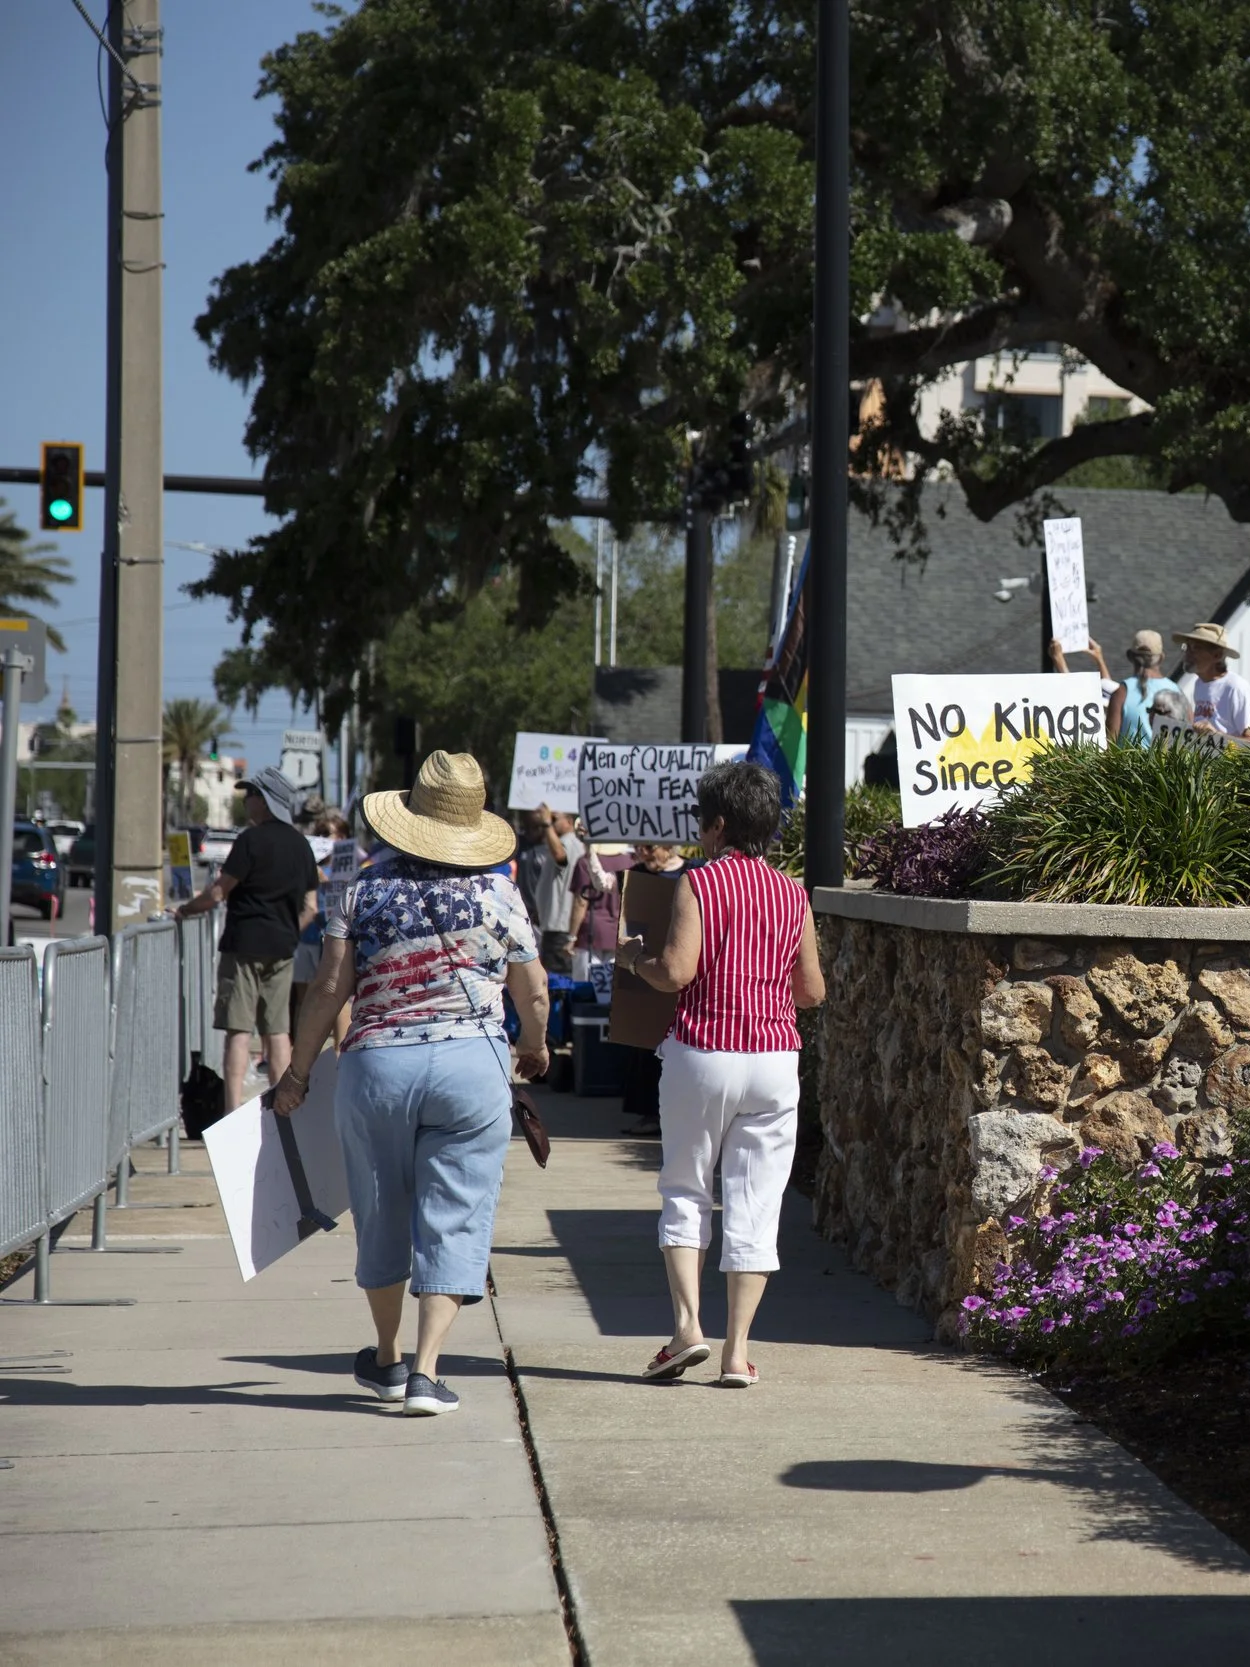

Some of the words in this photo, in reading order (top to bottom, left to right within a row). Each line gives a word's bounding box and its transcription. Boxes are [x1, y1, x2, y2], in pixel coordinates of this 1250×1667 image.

[994, 697, 1101, 742] Kings
[285, 733, 318, 746] NORTH
[297, 759, 304, 777] 1
[580, 745, 616, 771] Men
[621, 745, 640, 772] of
[641, 746, 713, 773] QUALITY
[588, 772, 645, 797] DON'T
[658, 776, 699, 800] FEA
